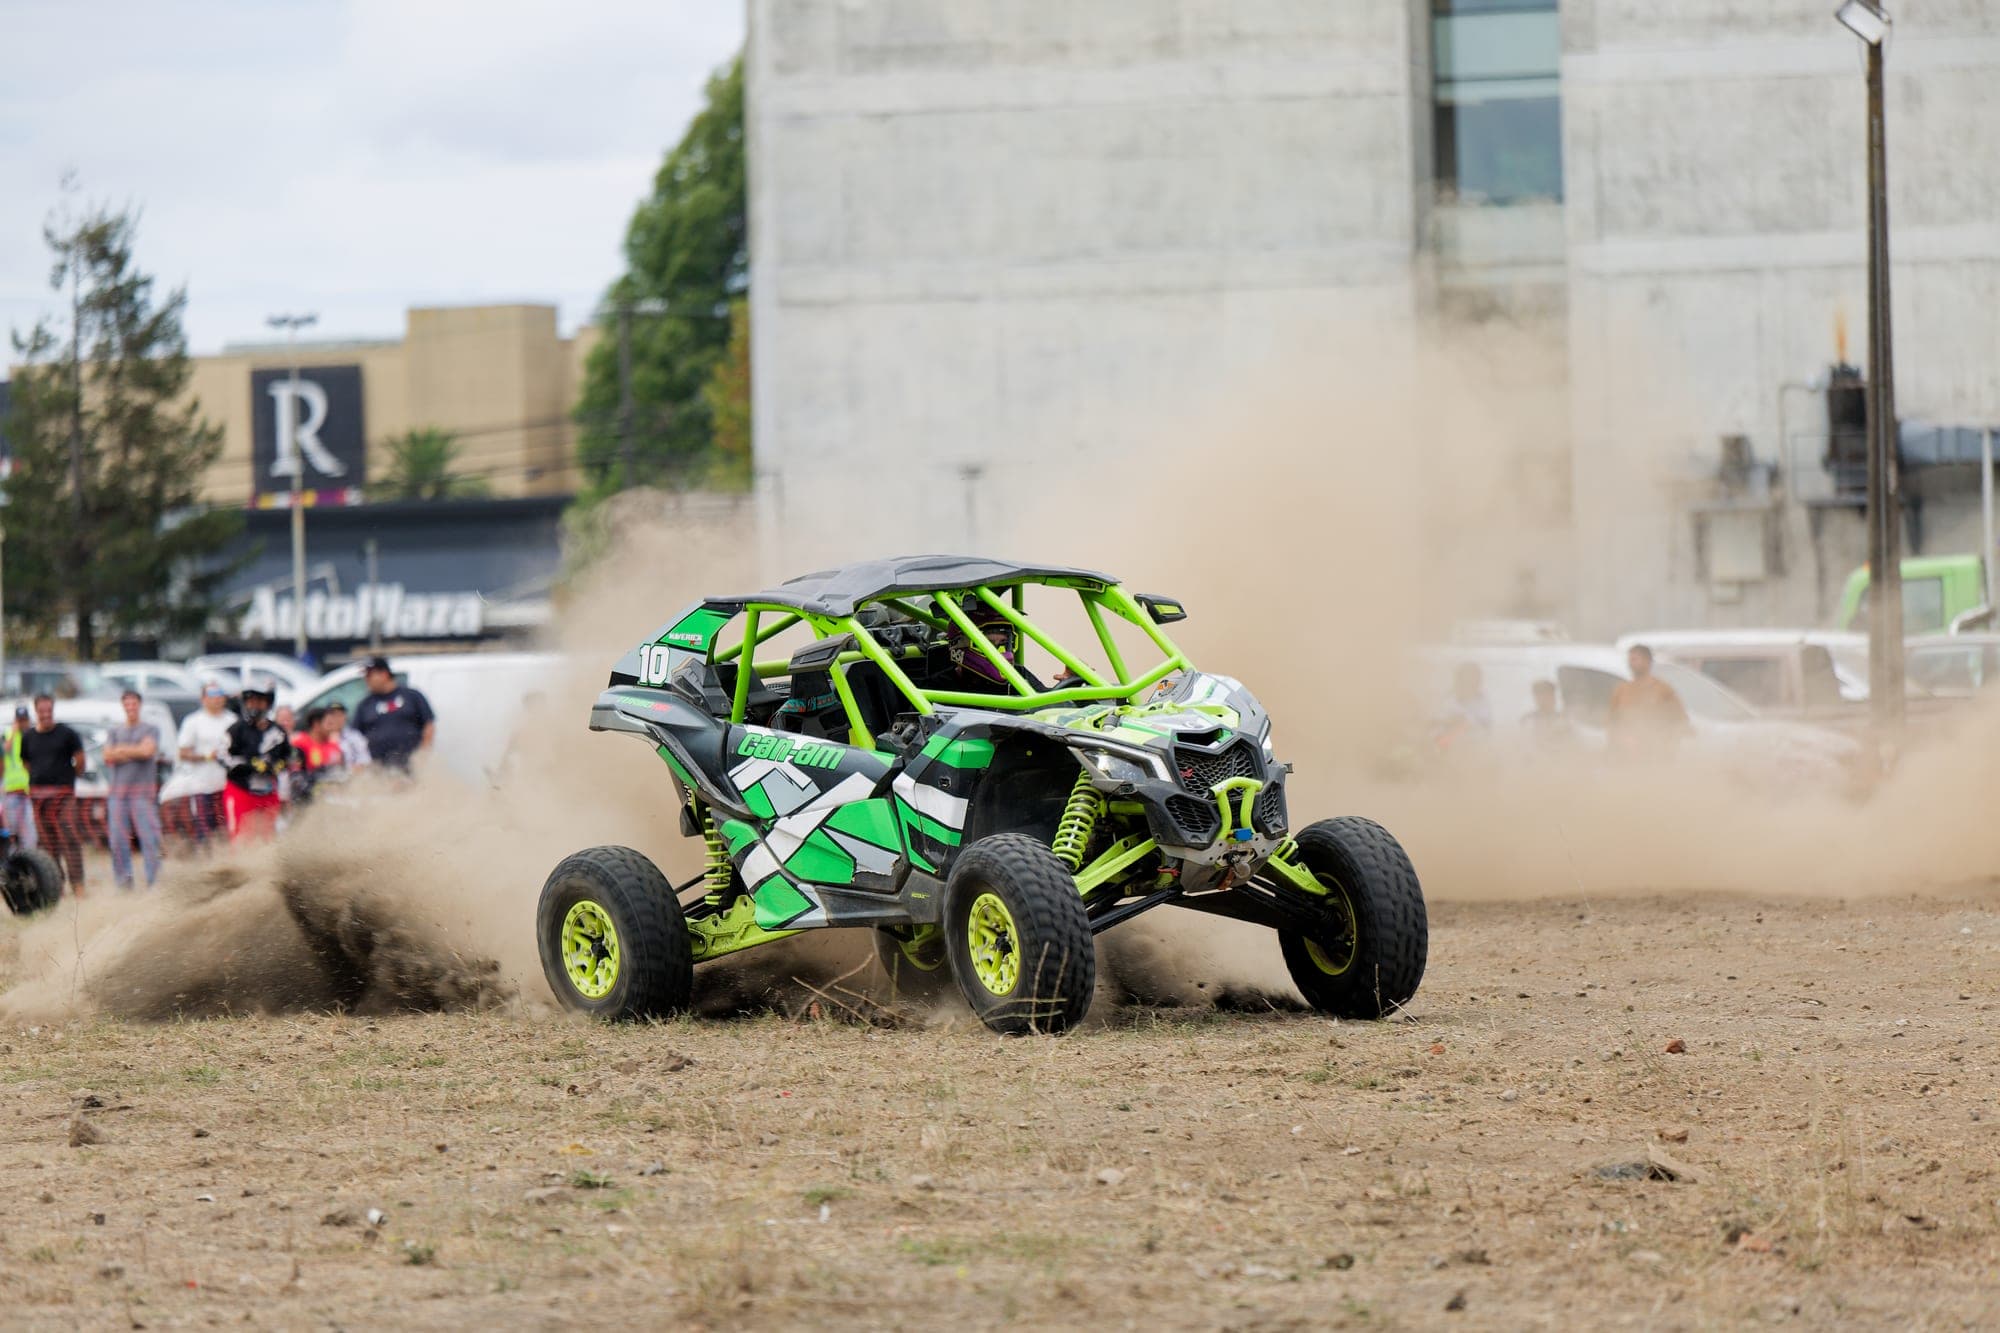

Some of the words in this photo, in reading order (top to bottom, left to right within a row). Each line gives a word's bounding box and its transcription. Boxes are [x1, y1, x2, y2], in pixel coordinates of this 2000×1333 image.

[267, 379, 347, 477] R
[240, 584, 481, 638] AutoPlaza
[638, 644, 670, 687] 10
[737, 733, 847, 770] can-am
